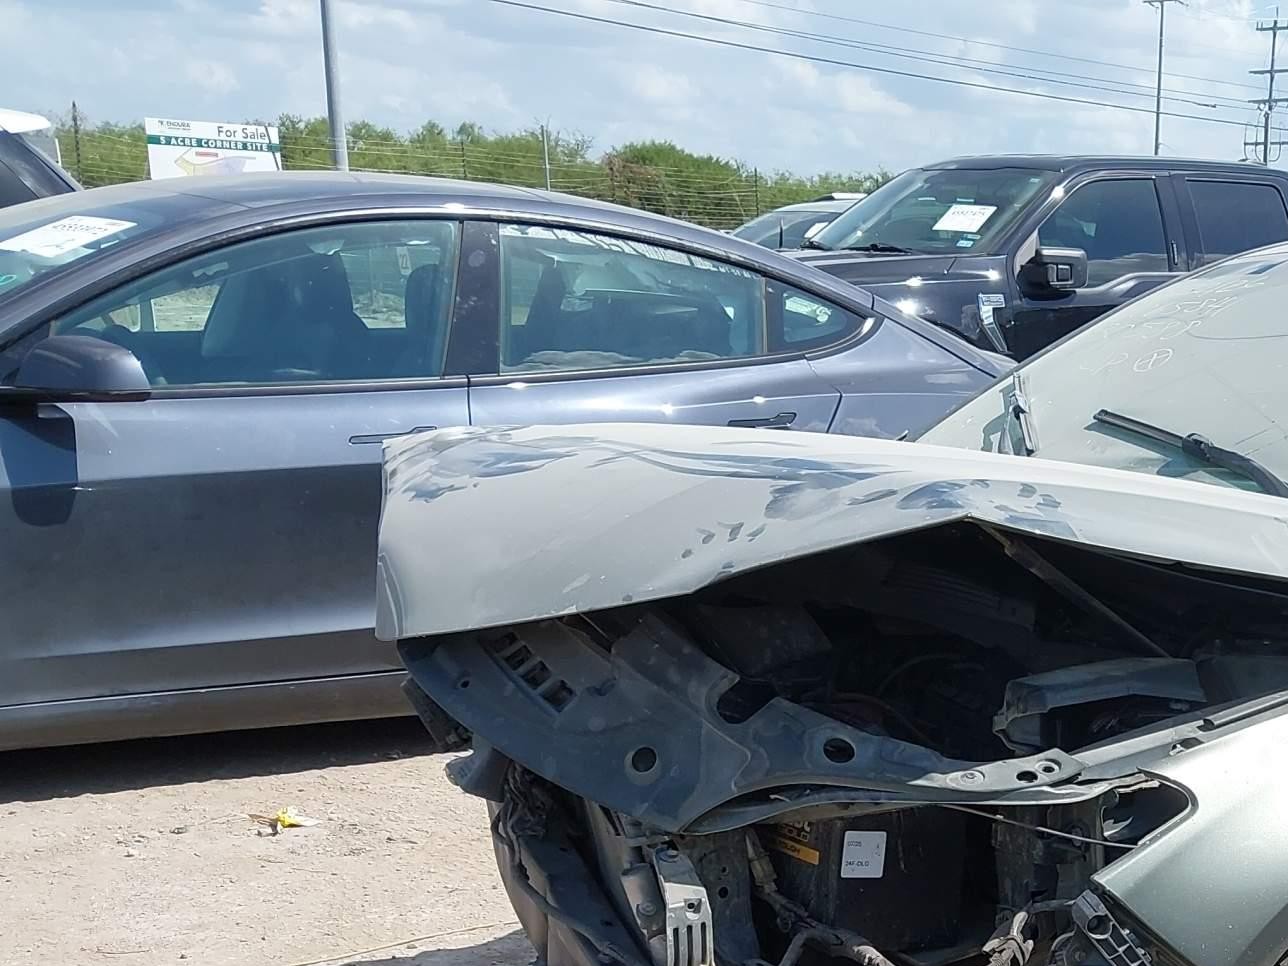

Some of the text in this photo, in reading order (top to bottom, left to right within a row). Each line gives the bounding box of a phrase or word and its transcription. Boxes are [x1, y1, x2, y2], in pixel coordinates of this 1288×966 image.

[217, 126, 267, 140] For Sale
[160, 136, 268, 151] 5 ACRE CORNER SITE
